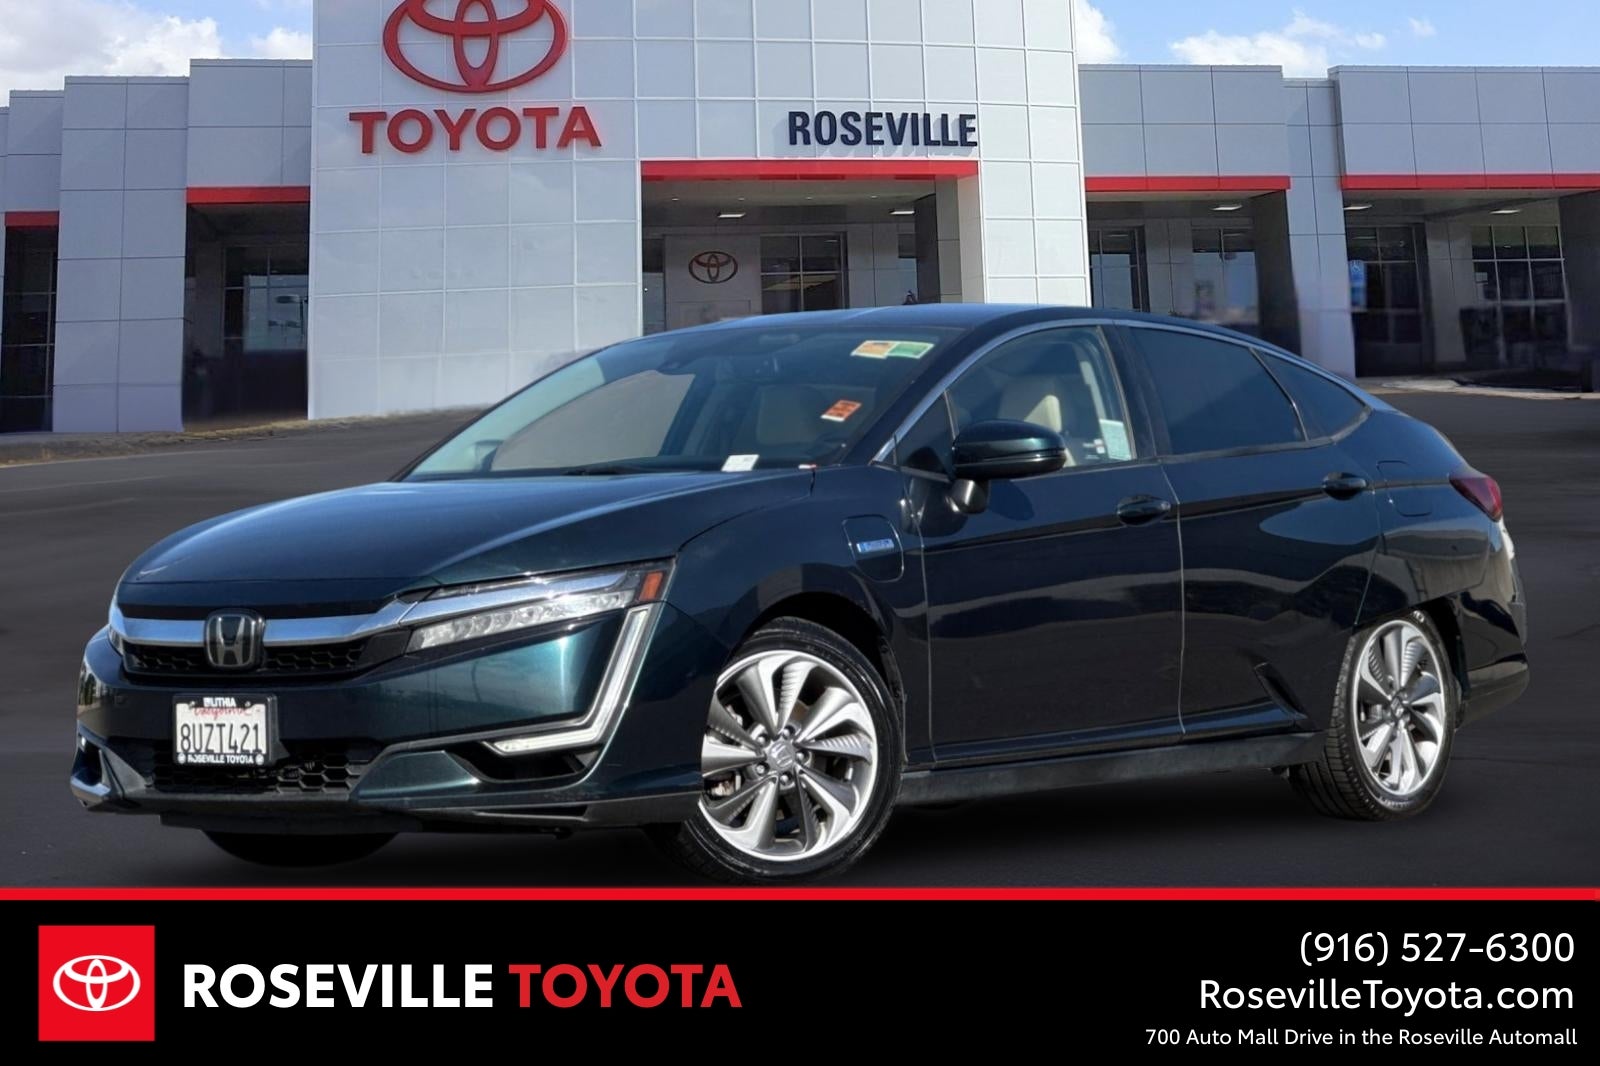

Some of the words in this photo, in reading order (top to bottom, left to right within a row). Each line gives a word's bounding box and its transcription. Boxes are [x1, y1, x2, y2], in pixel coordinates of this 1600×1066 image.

[349, 106, 602, 154] TOYOTA
[788, 110, 978, 148] ROSEVILLE
[180, 723, 263, 753] 8UZT421
[187, 754, 225, 763] ROSEVILLE
[226, 754, 254, 763] TOYOTA
